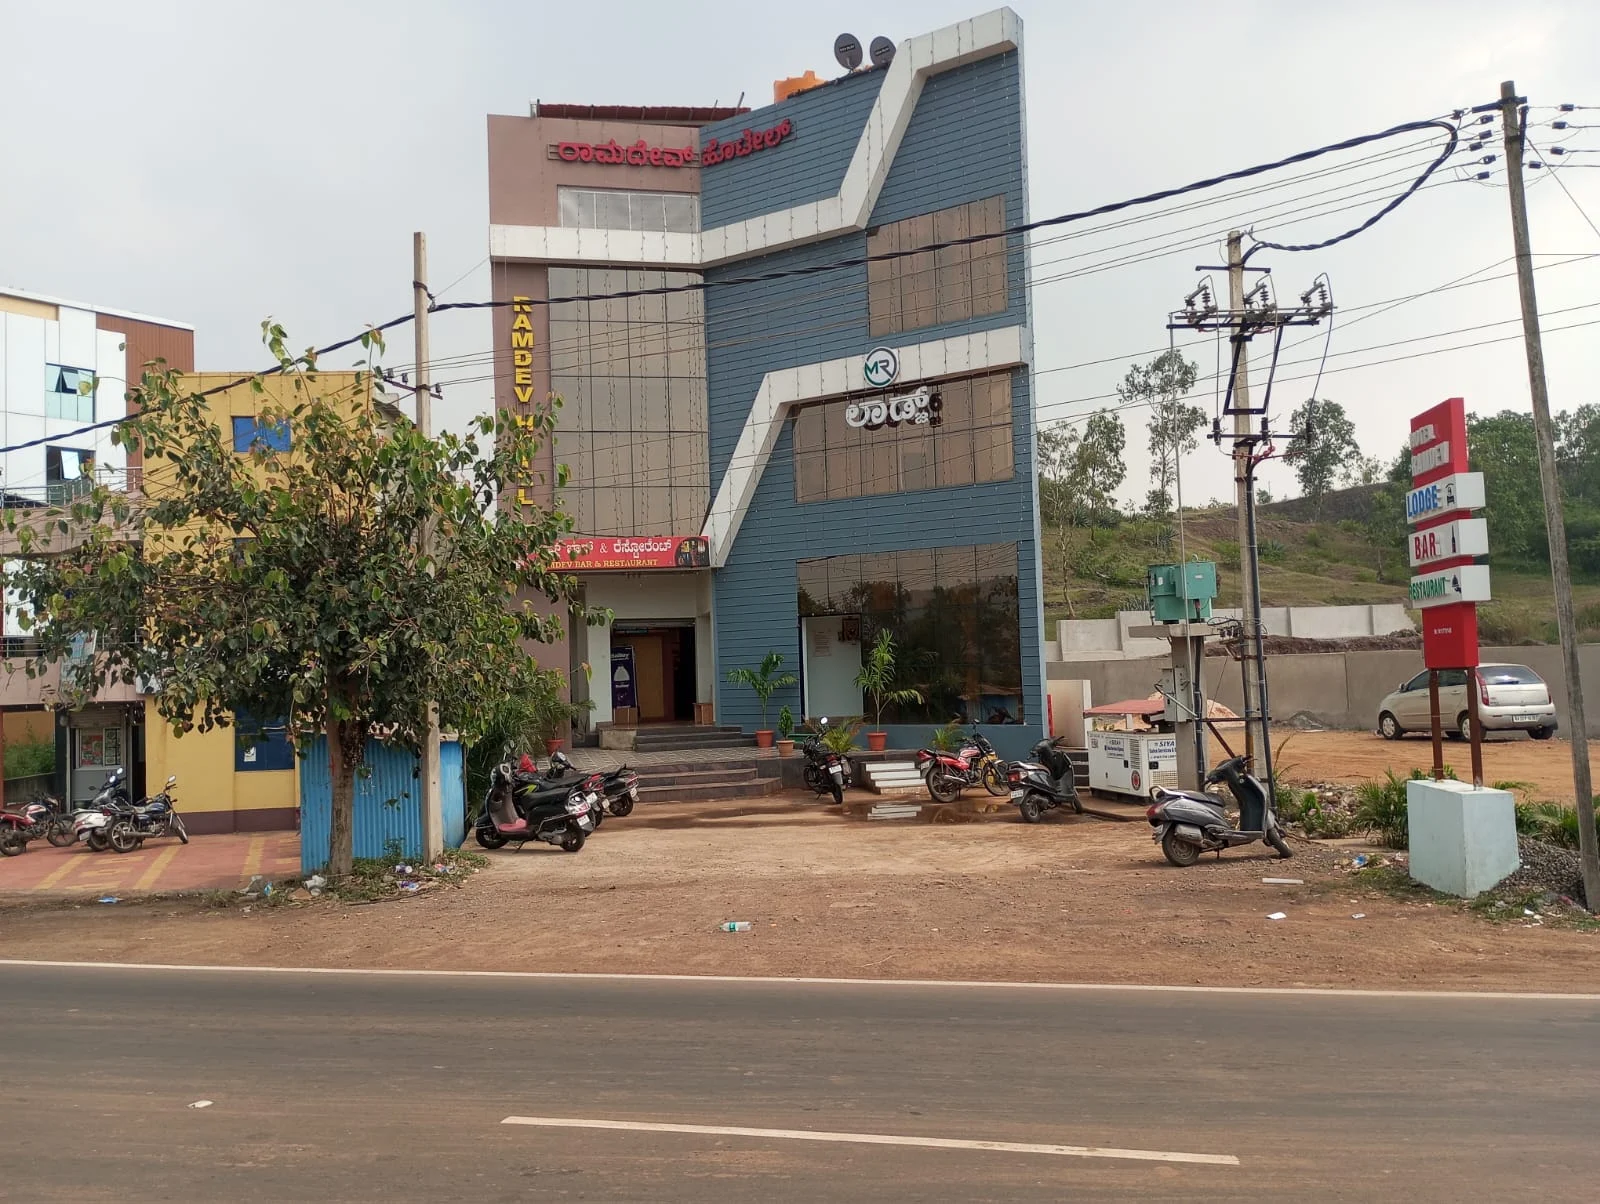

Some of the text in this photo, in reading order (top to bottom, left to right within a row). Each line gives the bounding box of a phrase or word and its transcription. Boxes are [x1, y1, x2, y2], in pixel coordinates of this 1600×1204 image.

[558, 138, 694, 168] ರಾಮದೇವ್
[512, 295, 535, 403] RAMDEV
[1407, 484, 1439, 517] LODGE
[599, 542, 609, 553] &
[1414, 532, 1438, 560] BAR
[575, 560, 592, 568] BAR
[603, 559, 659, 568] RESTAURANT
[1408, 577, 1446, 600] RESTAURANT
